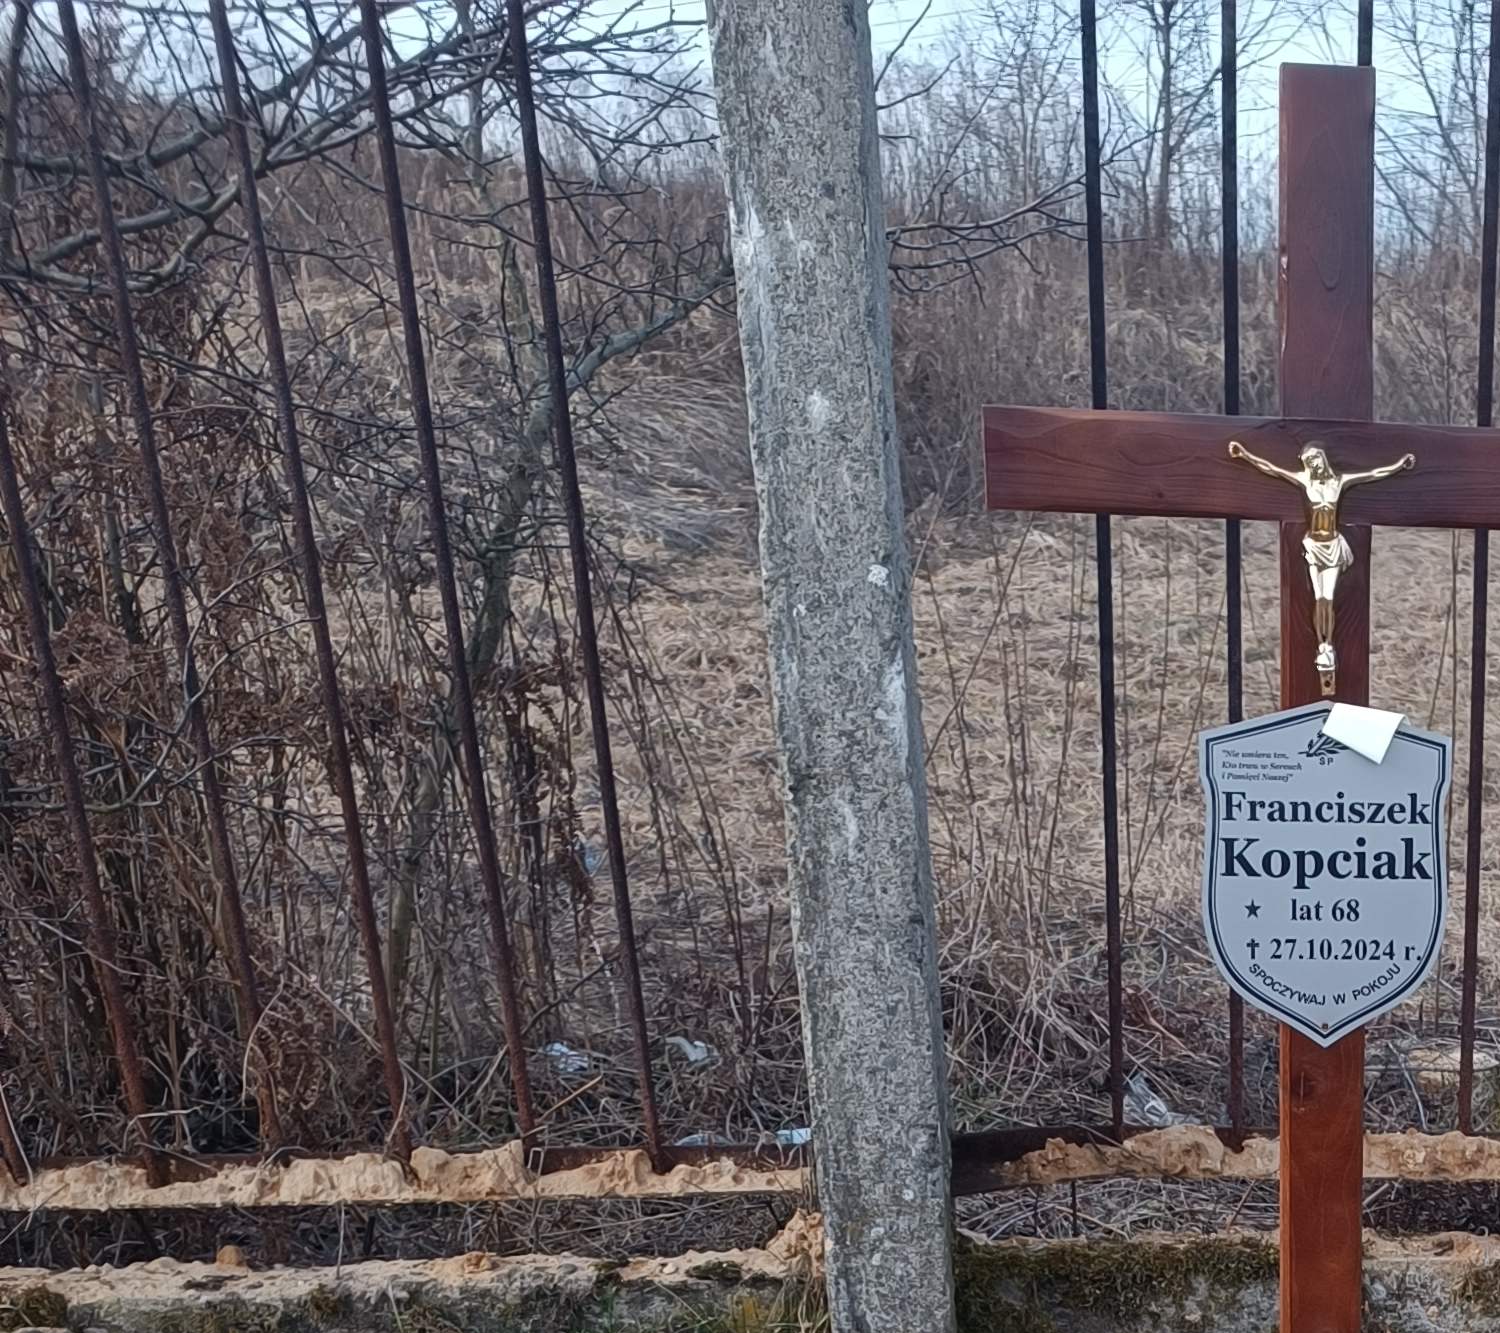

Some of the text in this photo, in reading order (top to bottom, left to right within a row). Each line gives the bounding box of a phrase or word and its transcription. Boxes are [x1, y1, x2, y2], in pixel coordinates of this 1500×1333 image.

[1221, 791, 1432, 825] Franciszek
[1219, 837, 1433, 889] Kopciak
[1290, 898, 1361, 921] lat 68
[1269, 938, 1422, 961] 27.10.2024 r.
[1249, 963, 1401, 1006] SPOCZYWAJ W POKOJU
